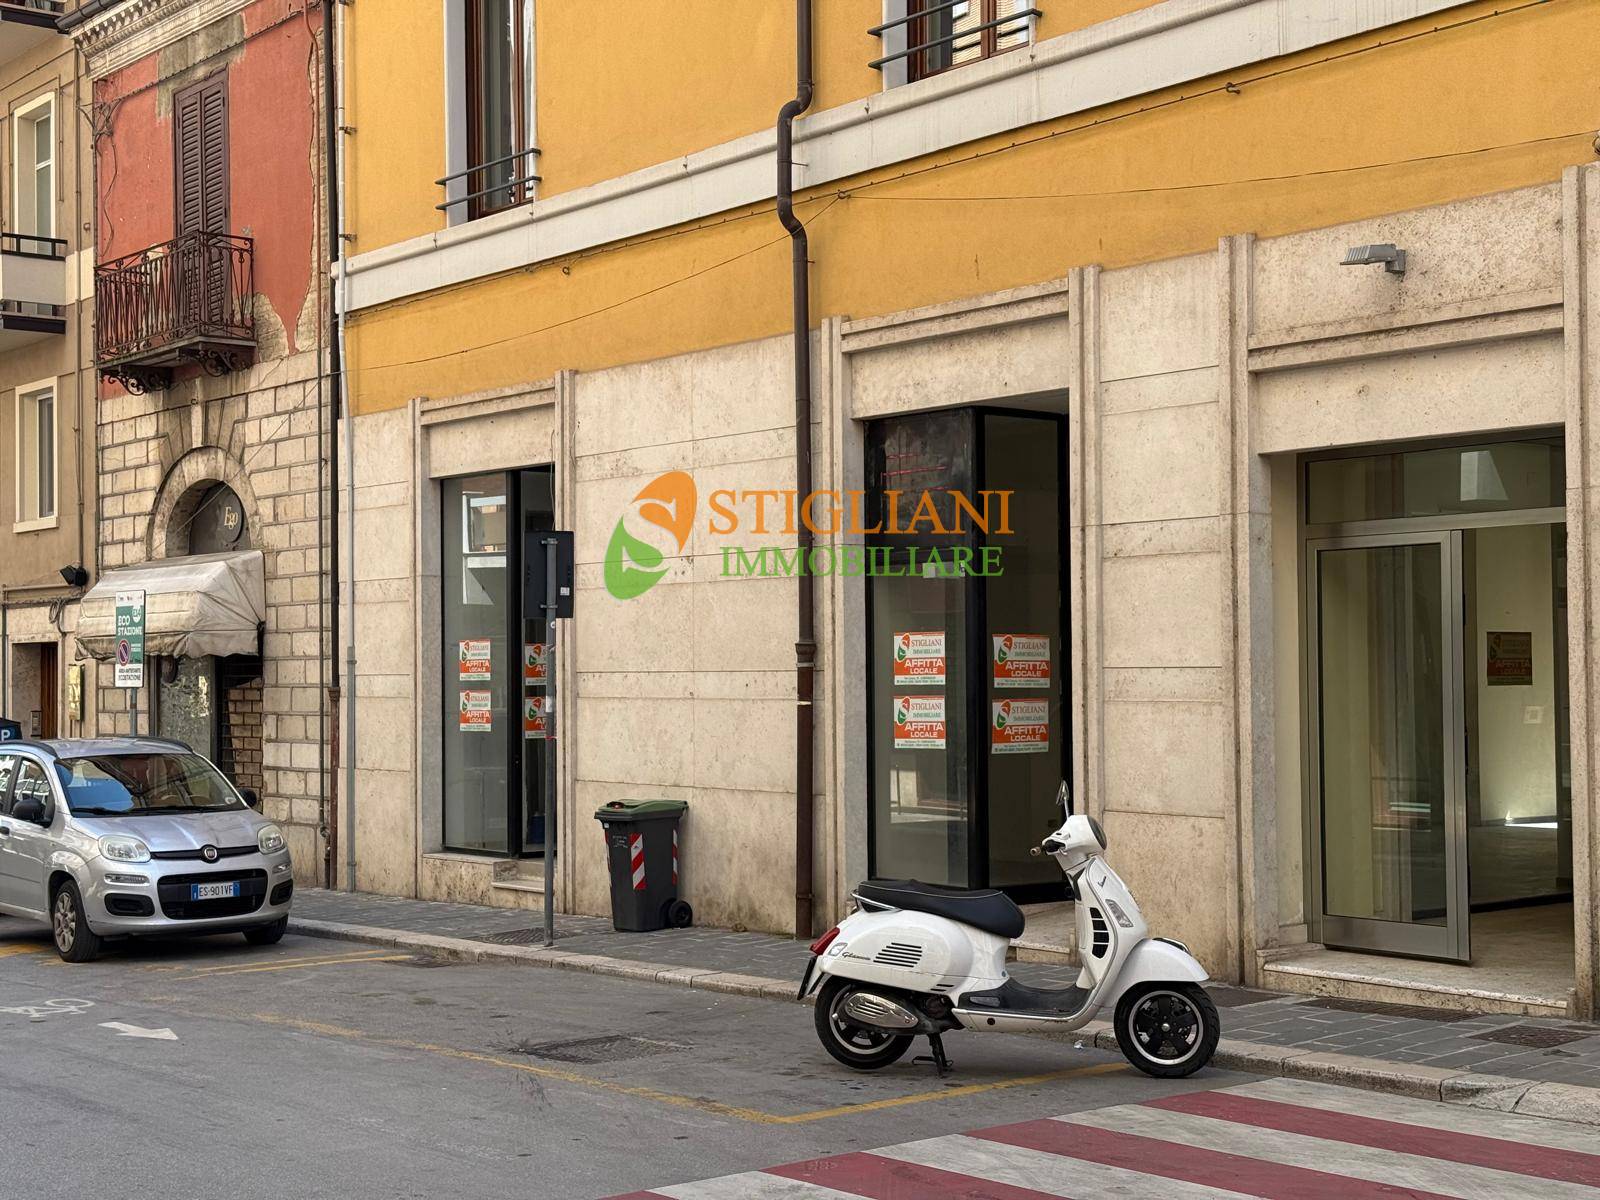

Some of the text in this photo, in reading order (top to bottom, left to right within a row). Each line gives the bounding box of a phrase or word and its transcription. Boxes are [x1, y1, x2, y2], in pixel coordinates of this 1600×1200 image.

[118, 615, 130, 626] ECO
[118, 626, 143, 636] STAZIONE
[911, 639, 942, 647] STIGLIANI
[904, 658, 945, 668] AFFITTA
[1005, 661, 1049, 670] AFFITTA
[911, 703, 942, 711] STIGLIANI
[904, 722, 944, 731] AFFITTA
[1004, 725, 1047, 735] AFFITTA
[1, 730, 10, 742] P
[1010, 734, 1041, 742] LOCALE
